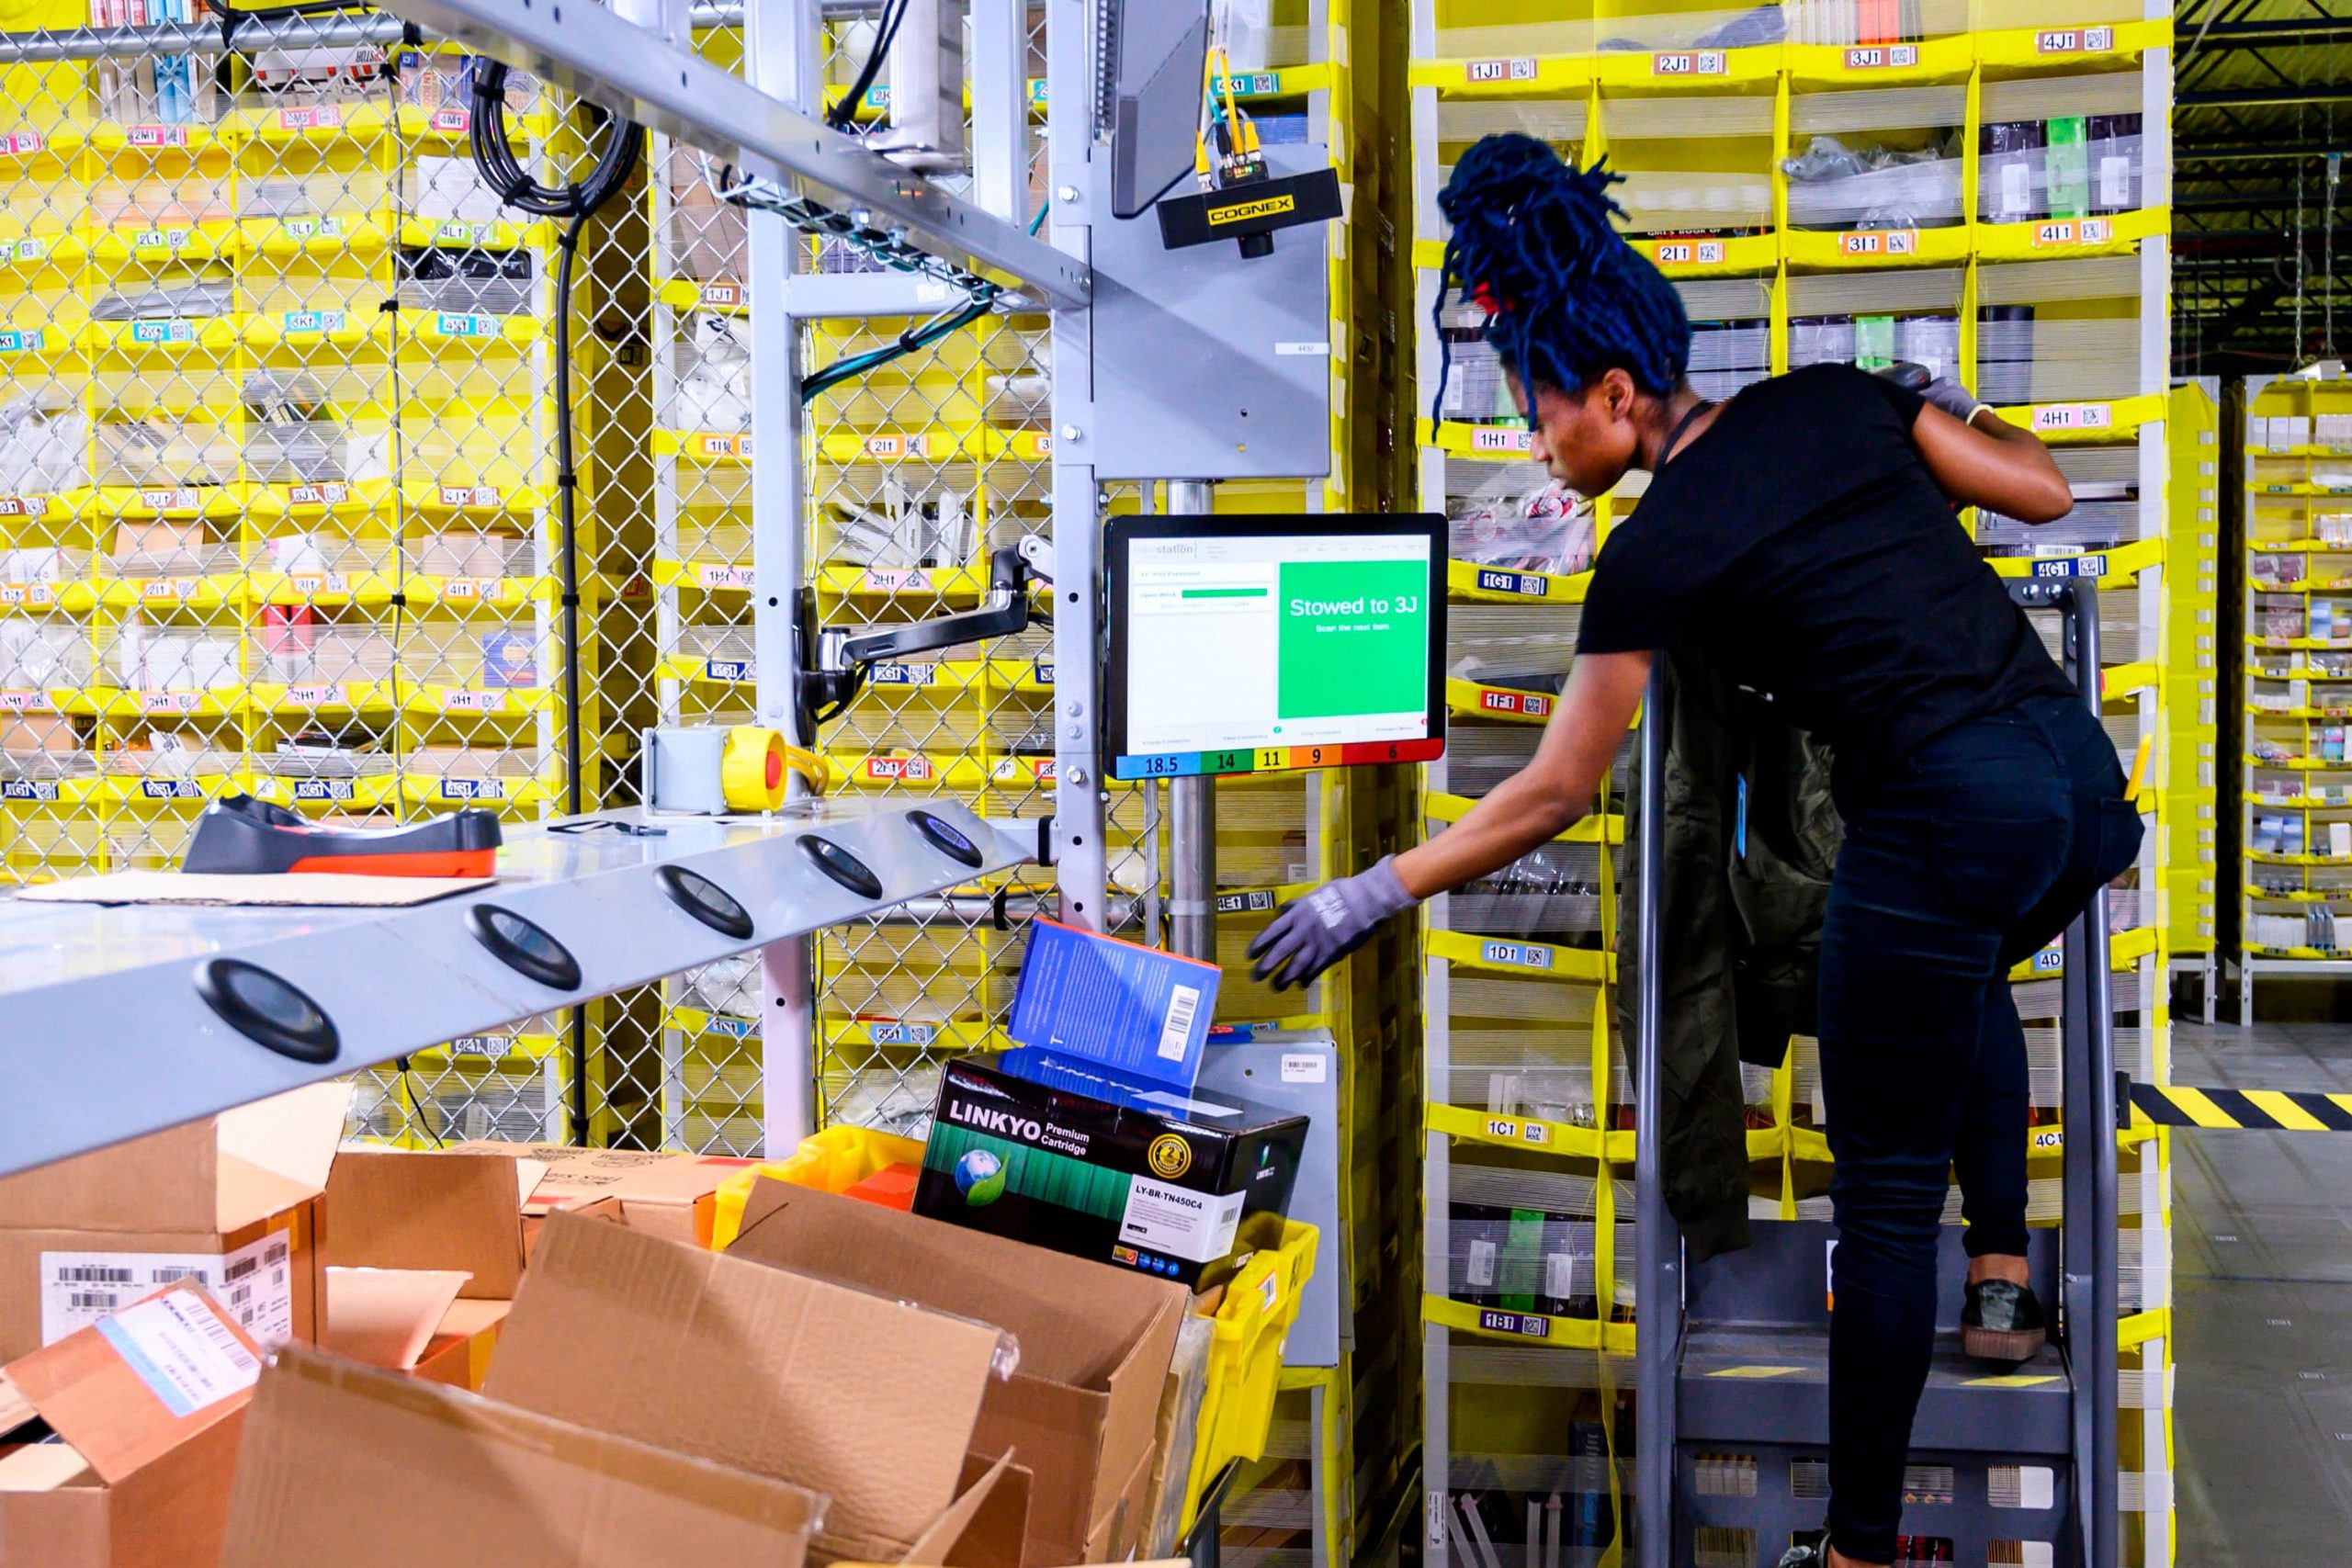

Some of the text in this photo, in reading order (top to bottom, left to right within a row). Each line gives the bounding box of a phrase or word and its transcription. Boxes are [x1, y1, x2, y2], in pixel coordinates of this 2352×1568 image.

[2045, 34, 2066, 49] 4J
[1661, 56, 1680, 72] 2J
[1852, 51, 1871, 65] 3J
[1475, 64, 1493, 78] 1J
[1210, 197, 1292, 222] COGNEX
[709, 289, 723, 300] 1J
[2041, 412, 2063, 425] 4H
[1480, 433, 1498, 446] 1H
[2039, 563, 2059, 577] 4G
[1486, 575, 1502, 588] 1G
[1290, 595, 1418, 616] Stowed to 3J
[1487, 694, 1505, 707] 1F
[1145, 744, 1396, 774] 18.5 14 11 9 6
[1489, 946, 1510, 959] 1D
[2041, 953, 2061, 967] 4D
[949, 1100, 1090, 1144] LINKYO Premium
[1489, 1122, 1508, 1134] 1C
[1041, 1134, 1087, 1156] Cartridge
[2036, 1134, 2056, 1146] 4C
[1136, 1185, 1203, 1210] LY-BR-TN450C4
[1487, 1314, 1505, 1327] 1B
